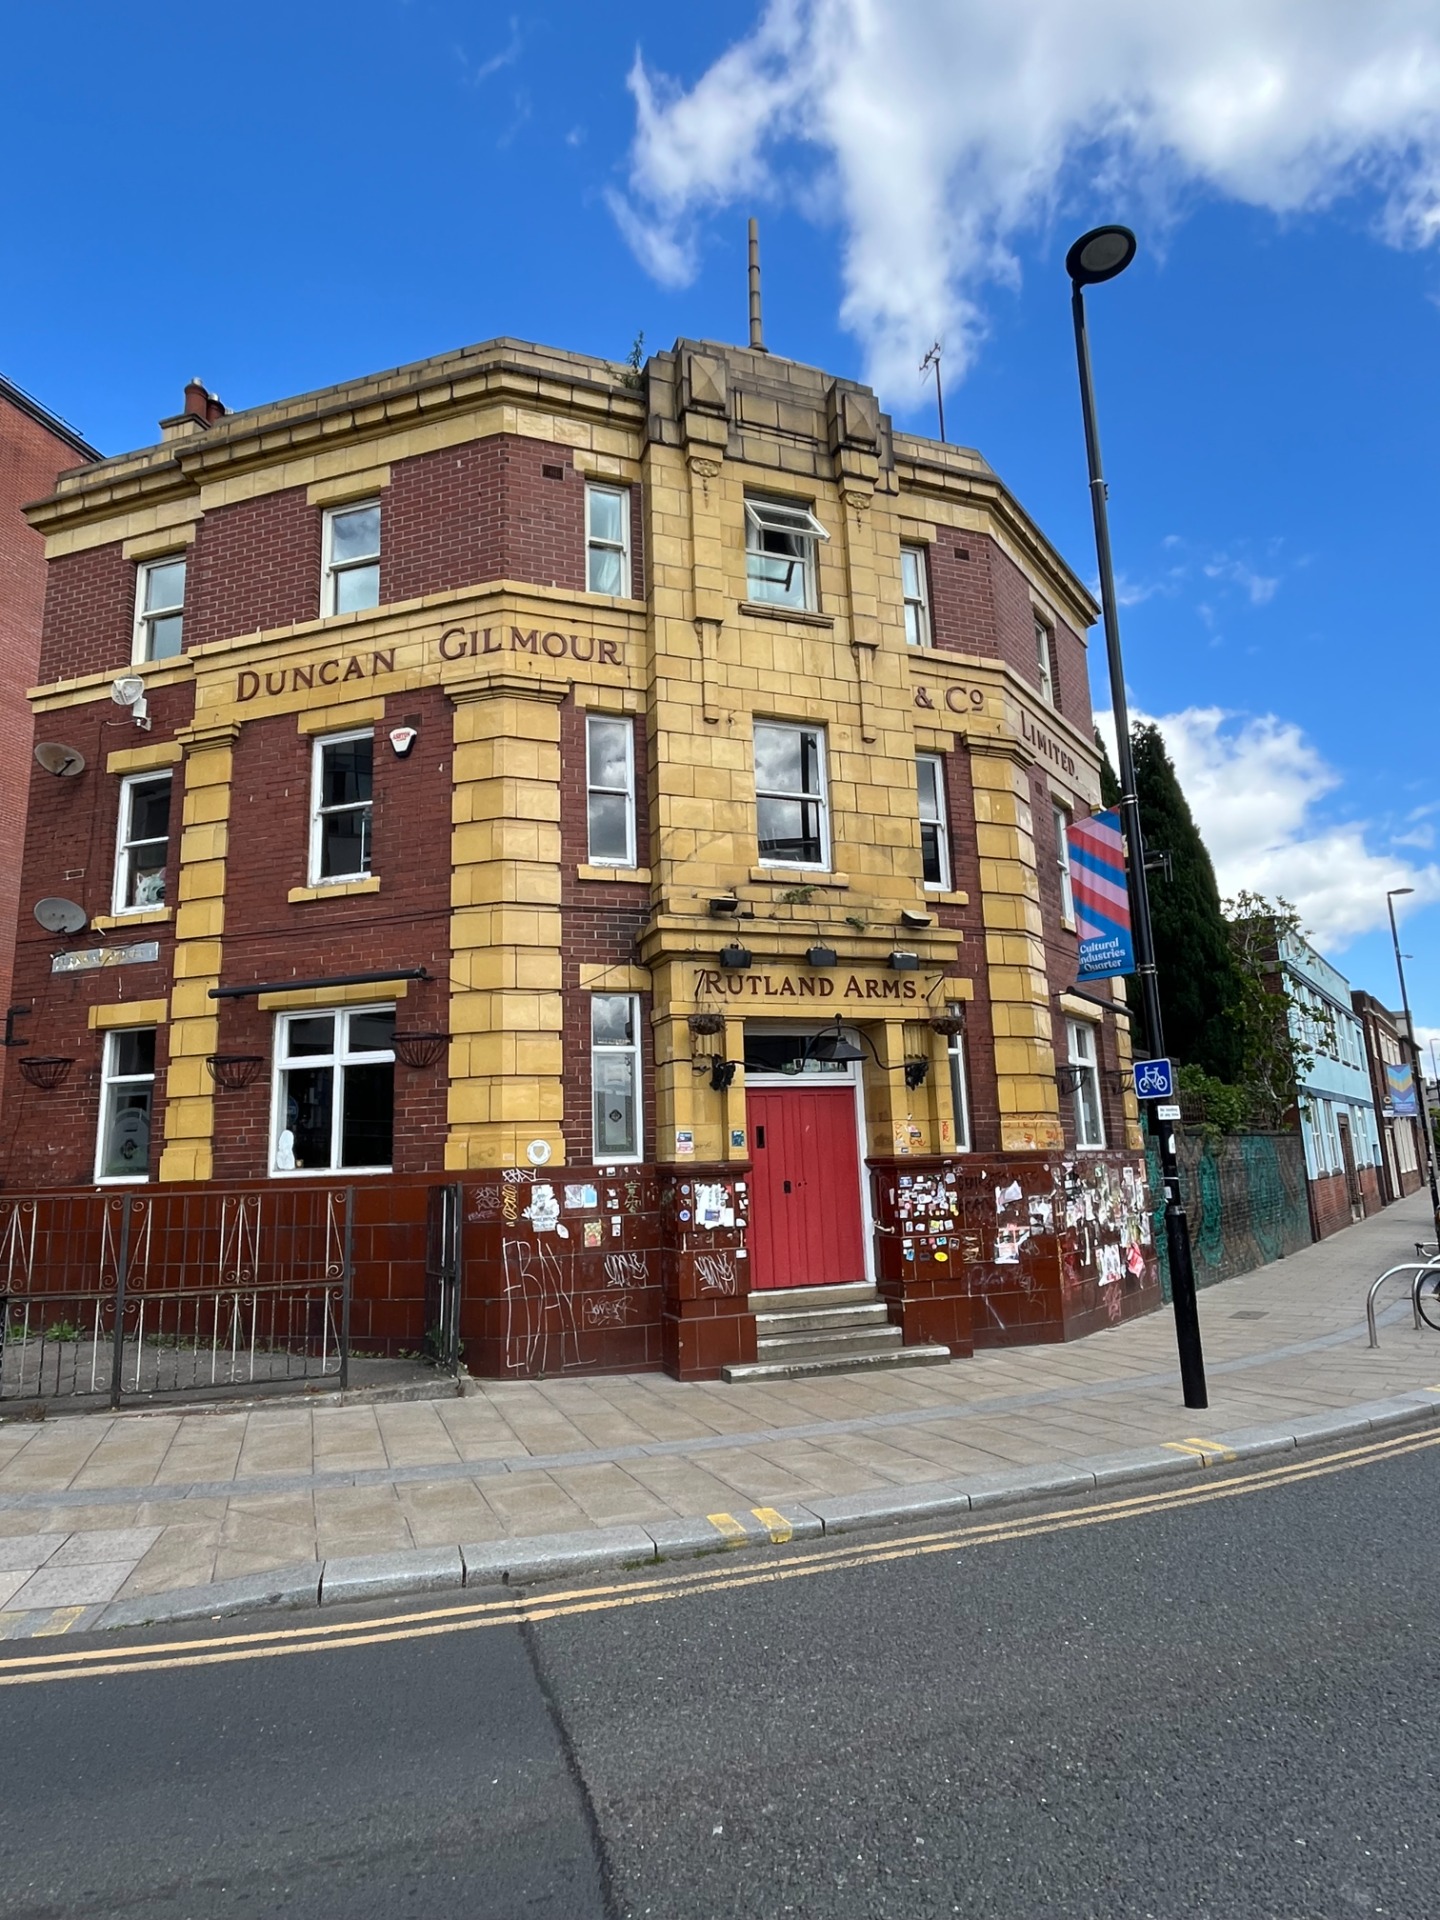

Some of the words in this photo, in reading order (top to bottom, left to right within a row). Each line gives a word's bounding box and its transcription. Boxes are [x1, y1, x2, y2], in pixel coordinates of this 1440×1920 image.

[237, 647, 397, 702] DUNCAN
[438, 626, 622, 666] GILMOUR
[914, 686, 935, 710] &
[1080, 937, 1119, 954] Cultural
[1079, 949, 1126, 965] ndustries
[1083, 959, 1122, 972] Quarter
[705, 970, 834, 997] RUTLAND
